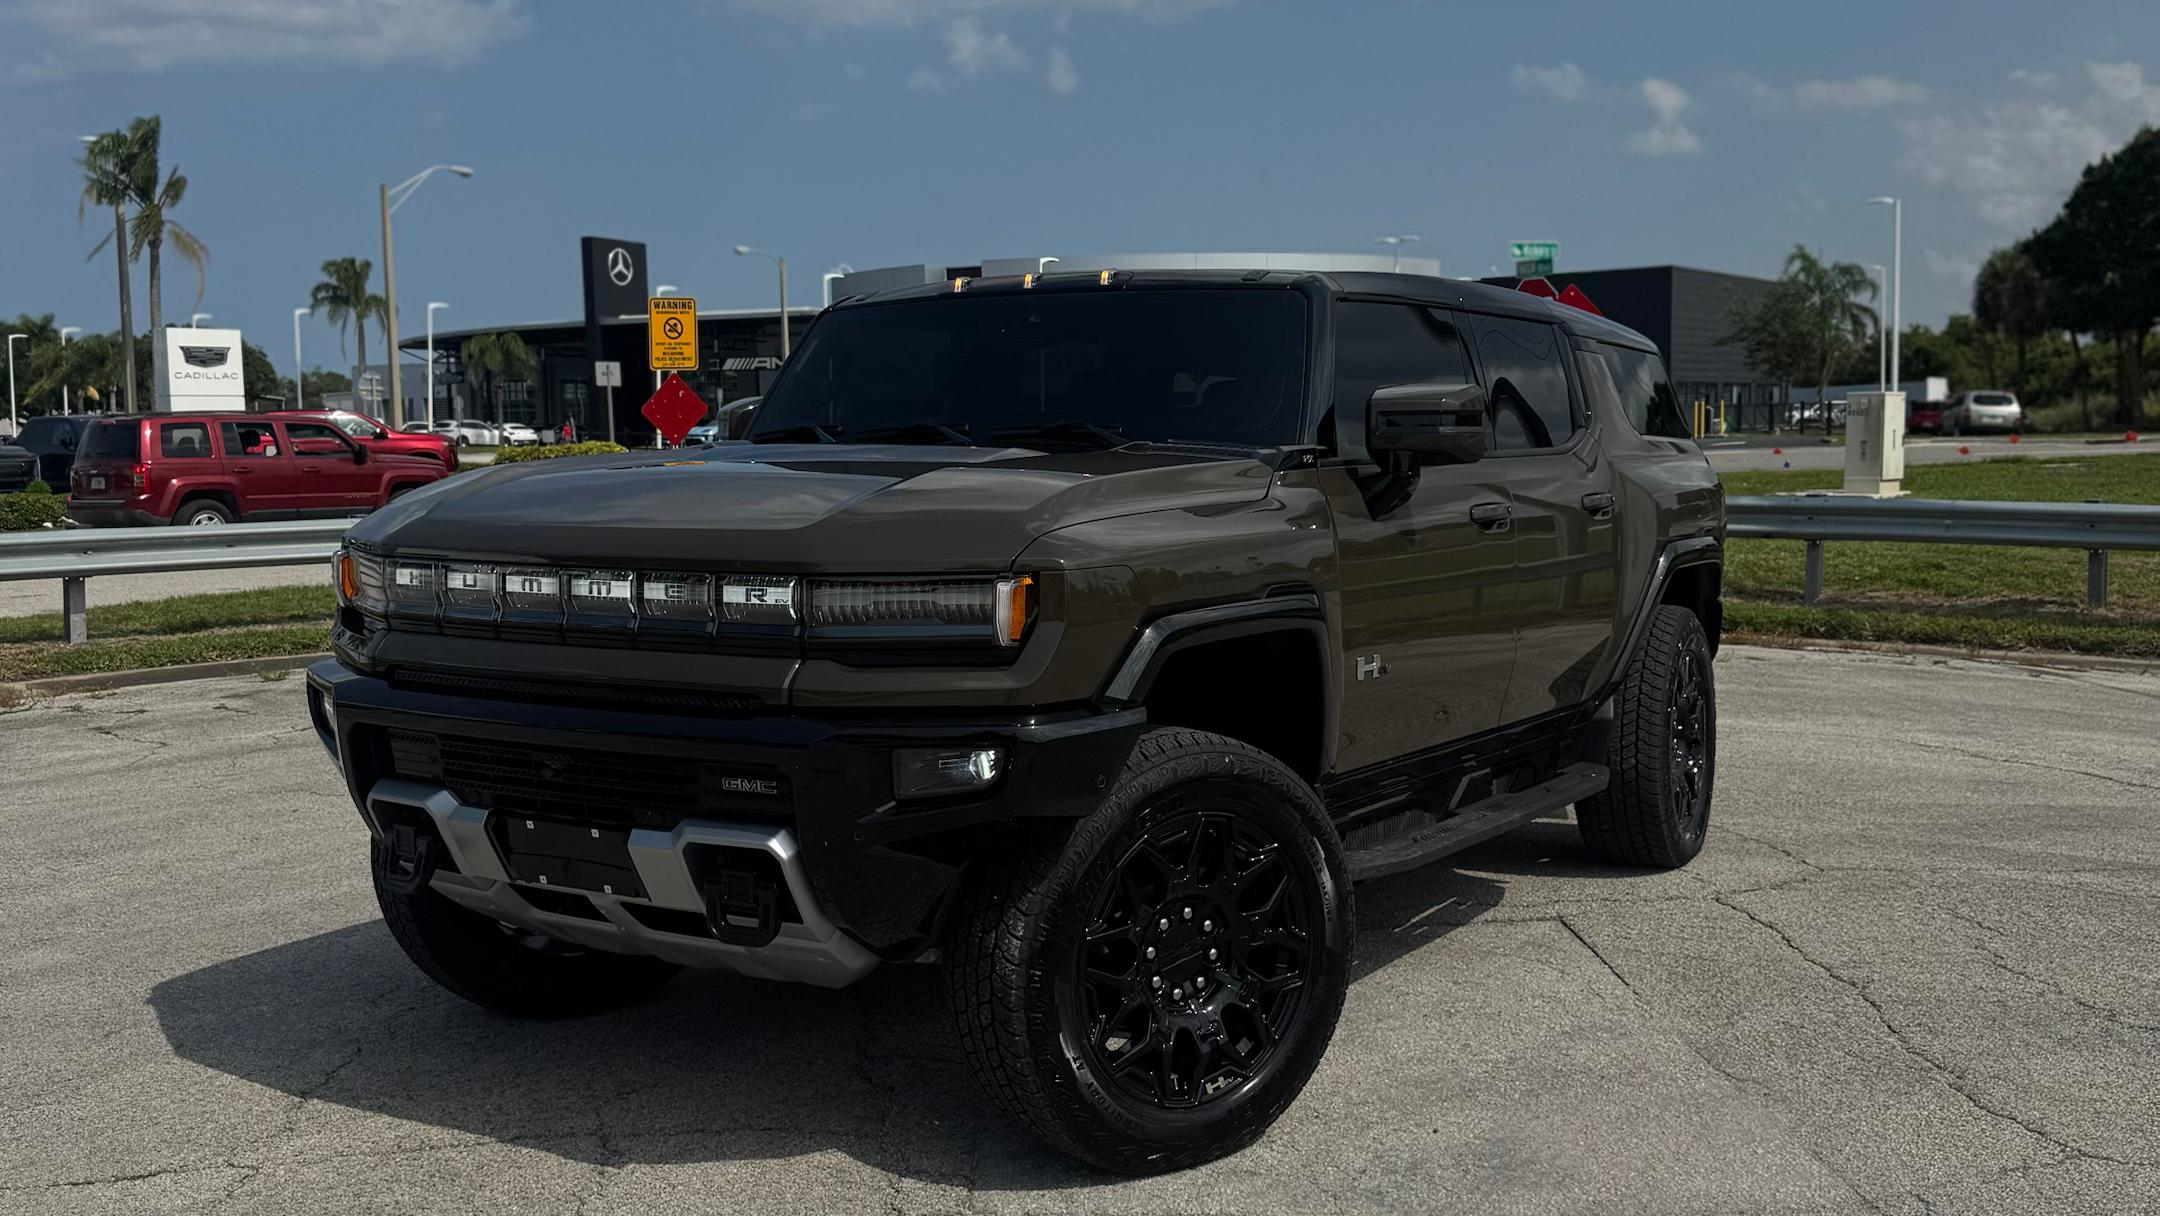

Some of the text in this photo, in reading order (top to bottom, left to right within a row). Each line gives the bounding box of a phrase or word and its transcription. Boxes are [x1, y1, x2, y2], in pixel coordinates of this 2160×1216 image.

[653, 301, 692, 310] WARNING
[174, 372, 239, 380] CADILLAC
[409, 570, 768, 603] HUMMER
[721, 777, 777, 794] GMC
